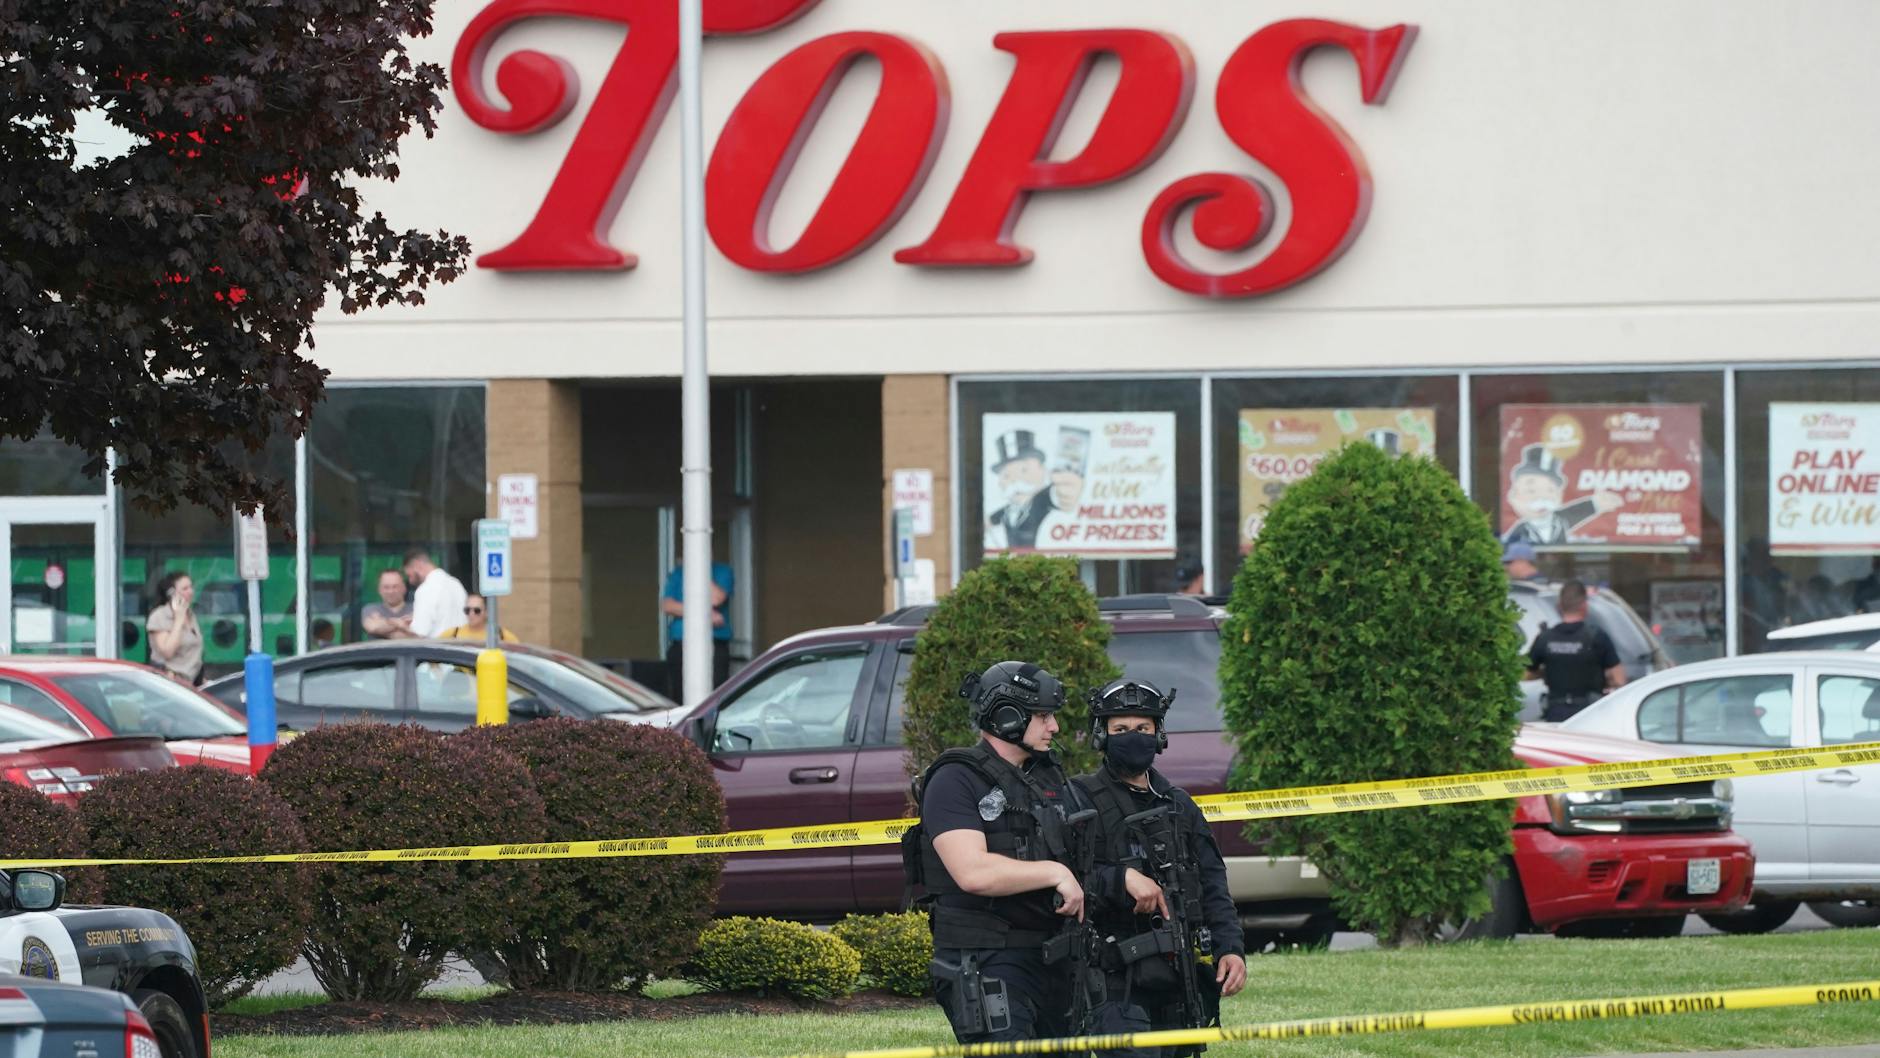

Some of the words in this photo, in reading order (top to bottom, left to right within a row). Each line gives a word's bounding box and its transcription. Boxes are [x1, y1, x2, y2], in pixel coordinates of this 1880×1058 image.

[450, 0, 1420, 298] TOPS
[1792, 450, 1864, 470] PLAY
[510, 482, 524, 493] NO
[1577, 469, 1691, 491] DIAMOND
[1777, 474, 1880, 494] ONLINE
[1077, 504, 1167, 519] MILLIONS
[1050, 524, 1081, 541] OF
[1084, 524, 1167, 541] PRIZES!
[86, 930, 121, 946] SERVING
[122, 928, 139, 943] THE
